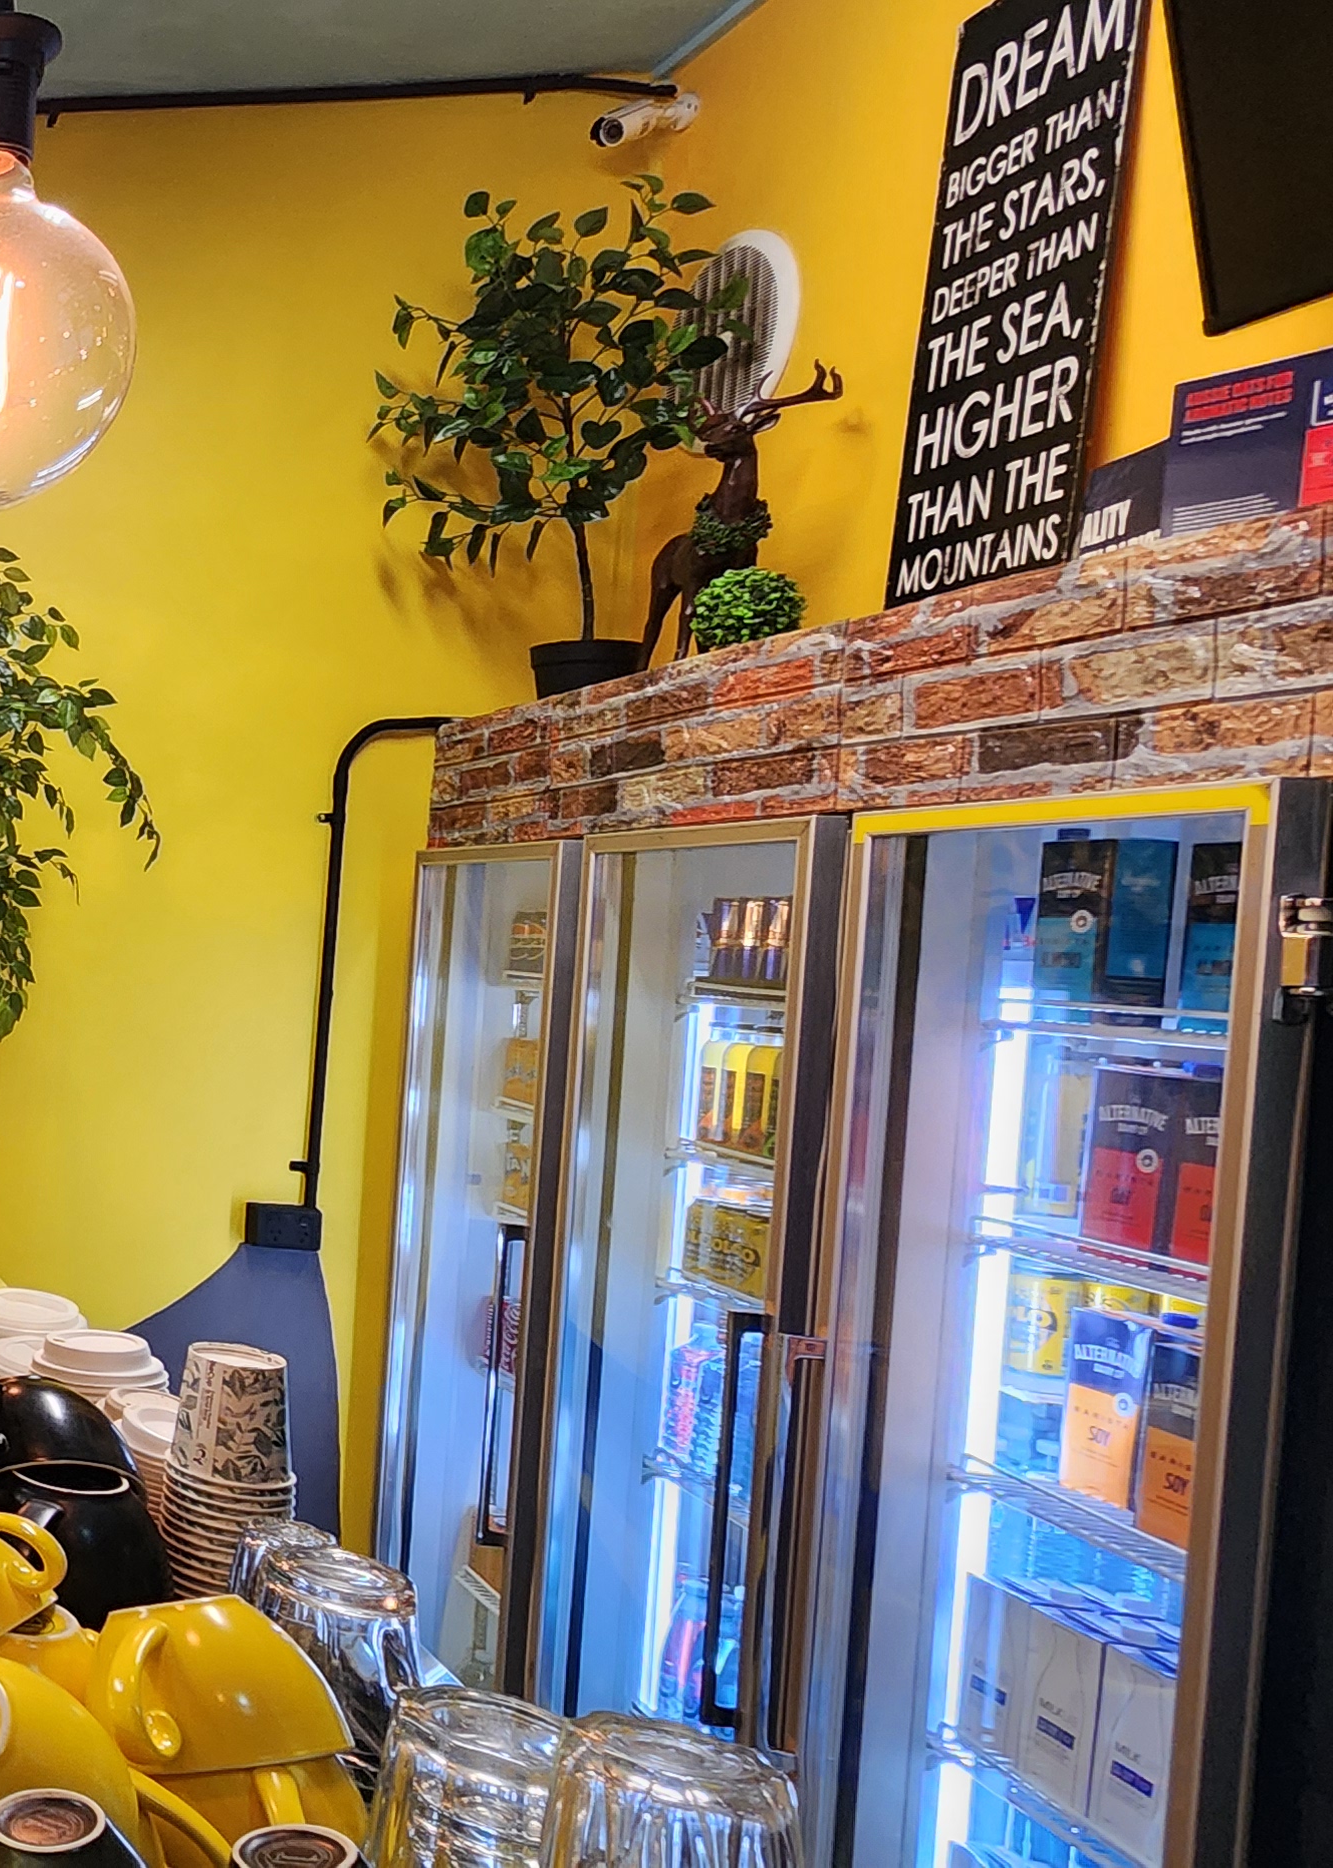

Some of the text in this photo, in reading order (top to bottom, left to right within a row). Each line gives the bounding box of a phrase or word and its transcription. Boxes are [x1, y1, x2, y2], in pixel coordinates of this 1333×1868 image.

[953, 0, 1128, 147] DREAM
[945, 80, 1120, 209] BIGGER THAN
[942, 147, 1106, 270] THE STARS,
[931, 212, 1099, 325] DEEPER THAN
[927, 281, 1084, 393] THE SEA,
[913, 355, 1080, 476] HIGHER
[907, 443, 1071, 543] THAN THE
[895, 513, 1062, 598] MOUNTAINS
[1099, 1104, 1169, 1132] ALTERNATIVE
[1088, 1426, 1111, 1446] SOY
[1162, 1472, 1191, 1496] SOY
